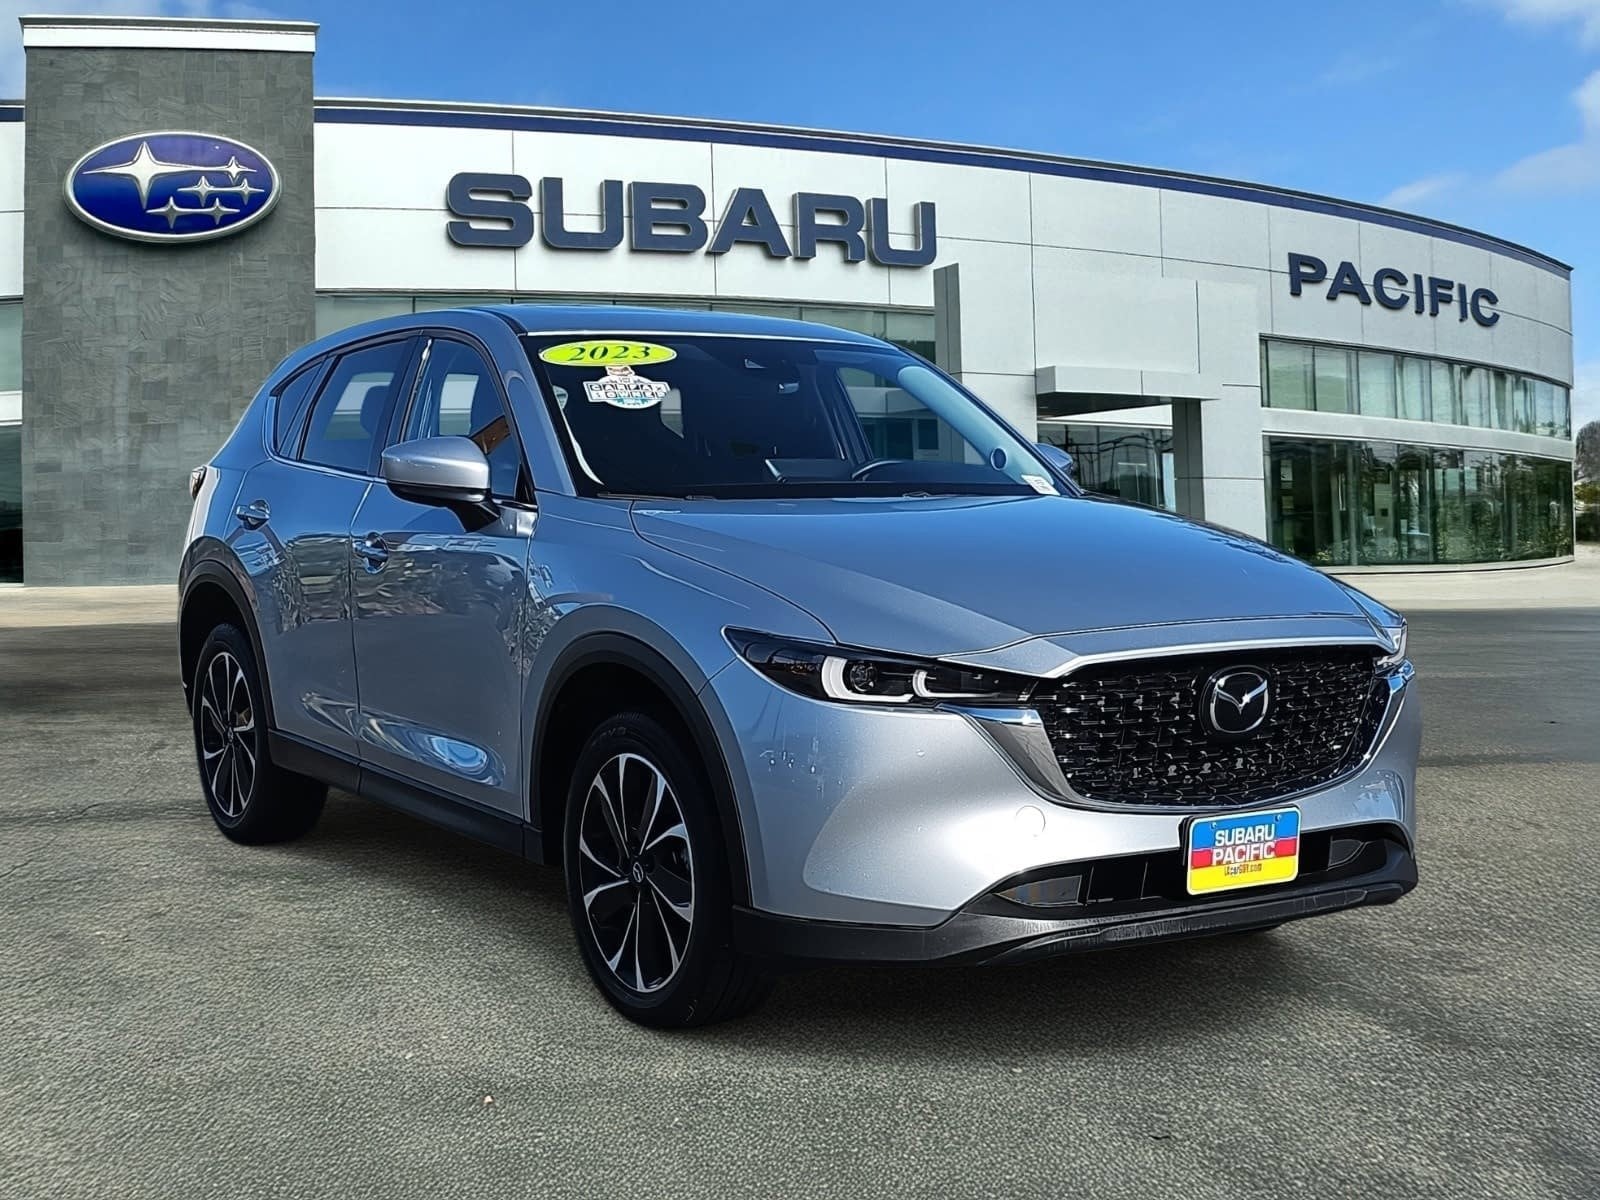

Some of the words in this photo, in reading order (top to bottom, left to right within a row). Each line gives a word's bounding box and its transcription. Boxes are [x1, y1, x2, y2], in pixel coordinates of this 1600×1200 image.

[446, 172, 937, 268] SUBARU
[1288, 252, 1500, 327] PACIFIC
[567, 346, 651, 361] 2023
[1215, 824, 1275, 846] SUBARU
[1212, 842, 1275, 865] PACIFIC
